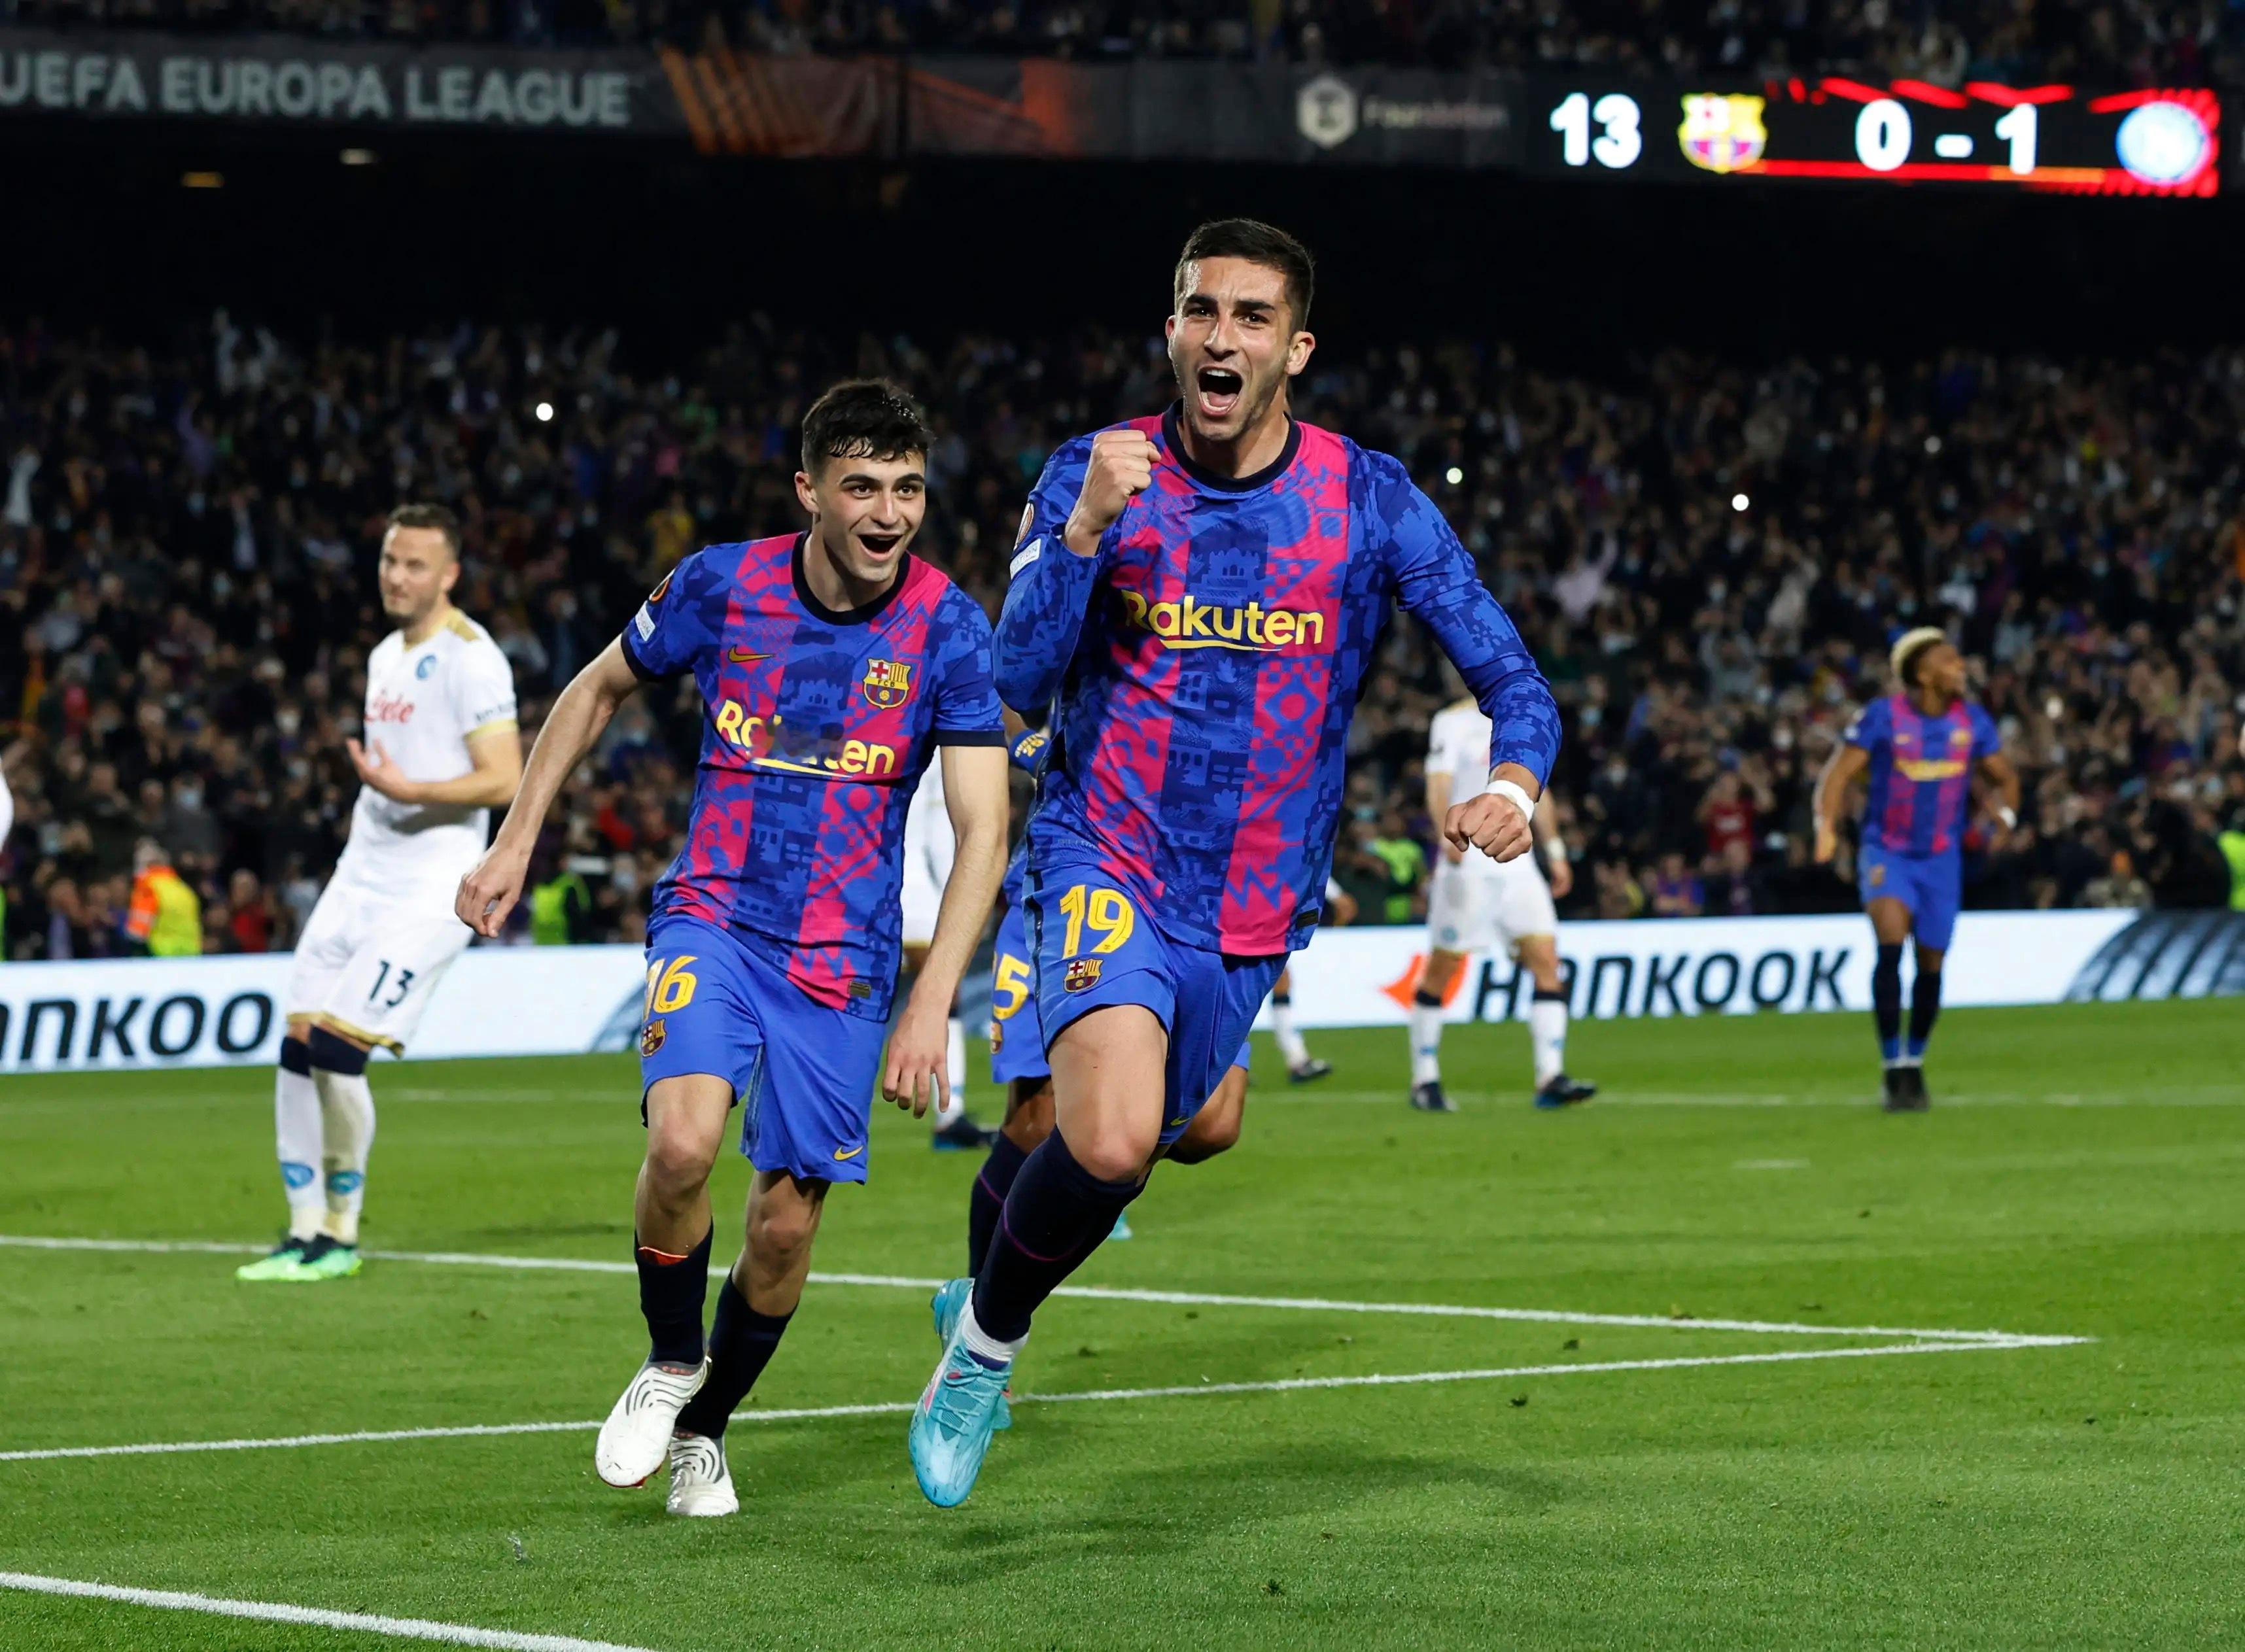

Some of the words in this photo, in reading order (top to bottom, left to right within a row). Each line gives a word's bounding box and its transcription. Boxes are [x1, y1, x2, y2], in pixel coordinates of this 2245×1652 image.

[0, 52, 146, 111] UEFA
[162, 58, 389, 119] EUROPA
[405, 67, 629, 126] LEAGUE
[1550, 92, 1643, 169] 13
[1855, 98, 1912, 171] 0
[1995, 103, 2038, 175] 1
[1121, 589, 1324, 645] Rakuten
[1060, 885, 1134, 959] 19
[369, 959, 415, 1008] 13
[644, 955, 699, 1023] 16
[992, 951, 1030, 1020] 5
